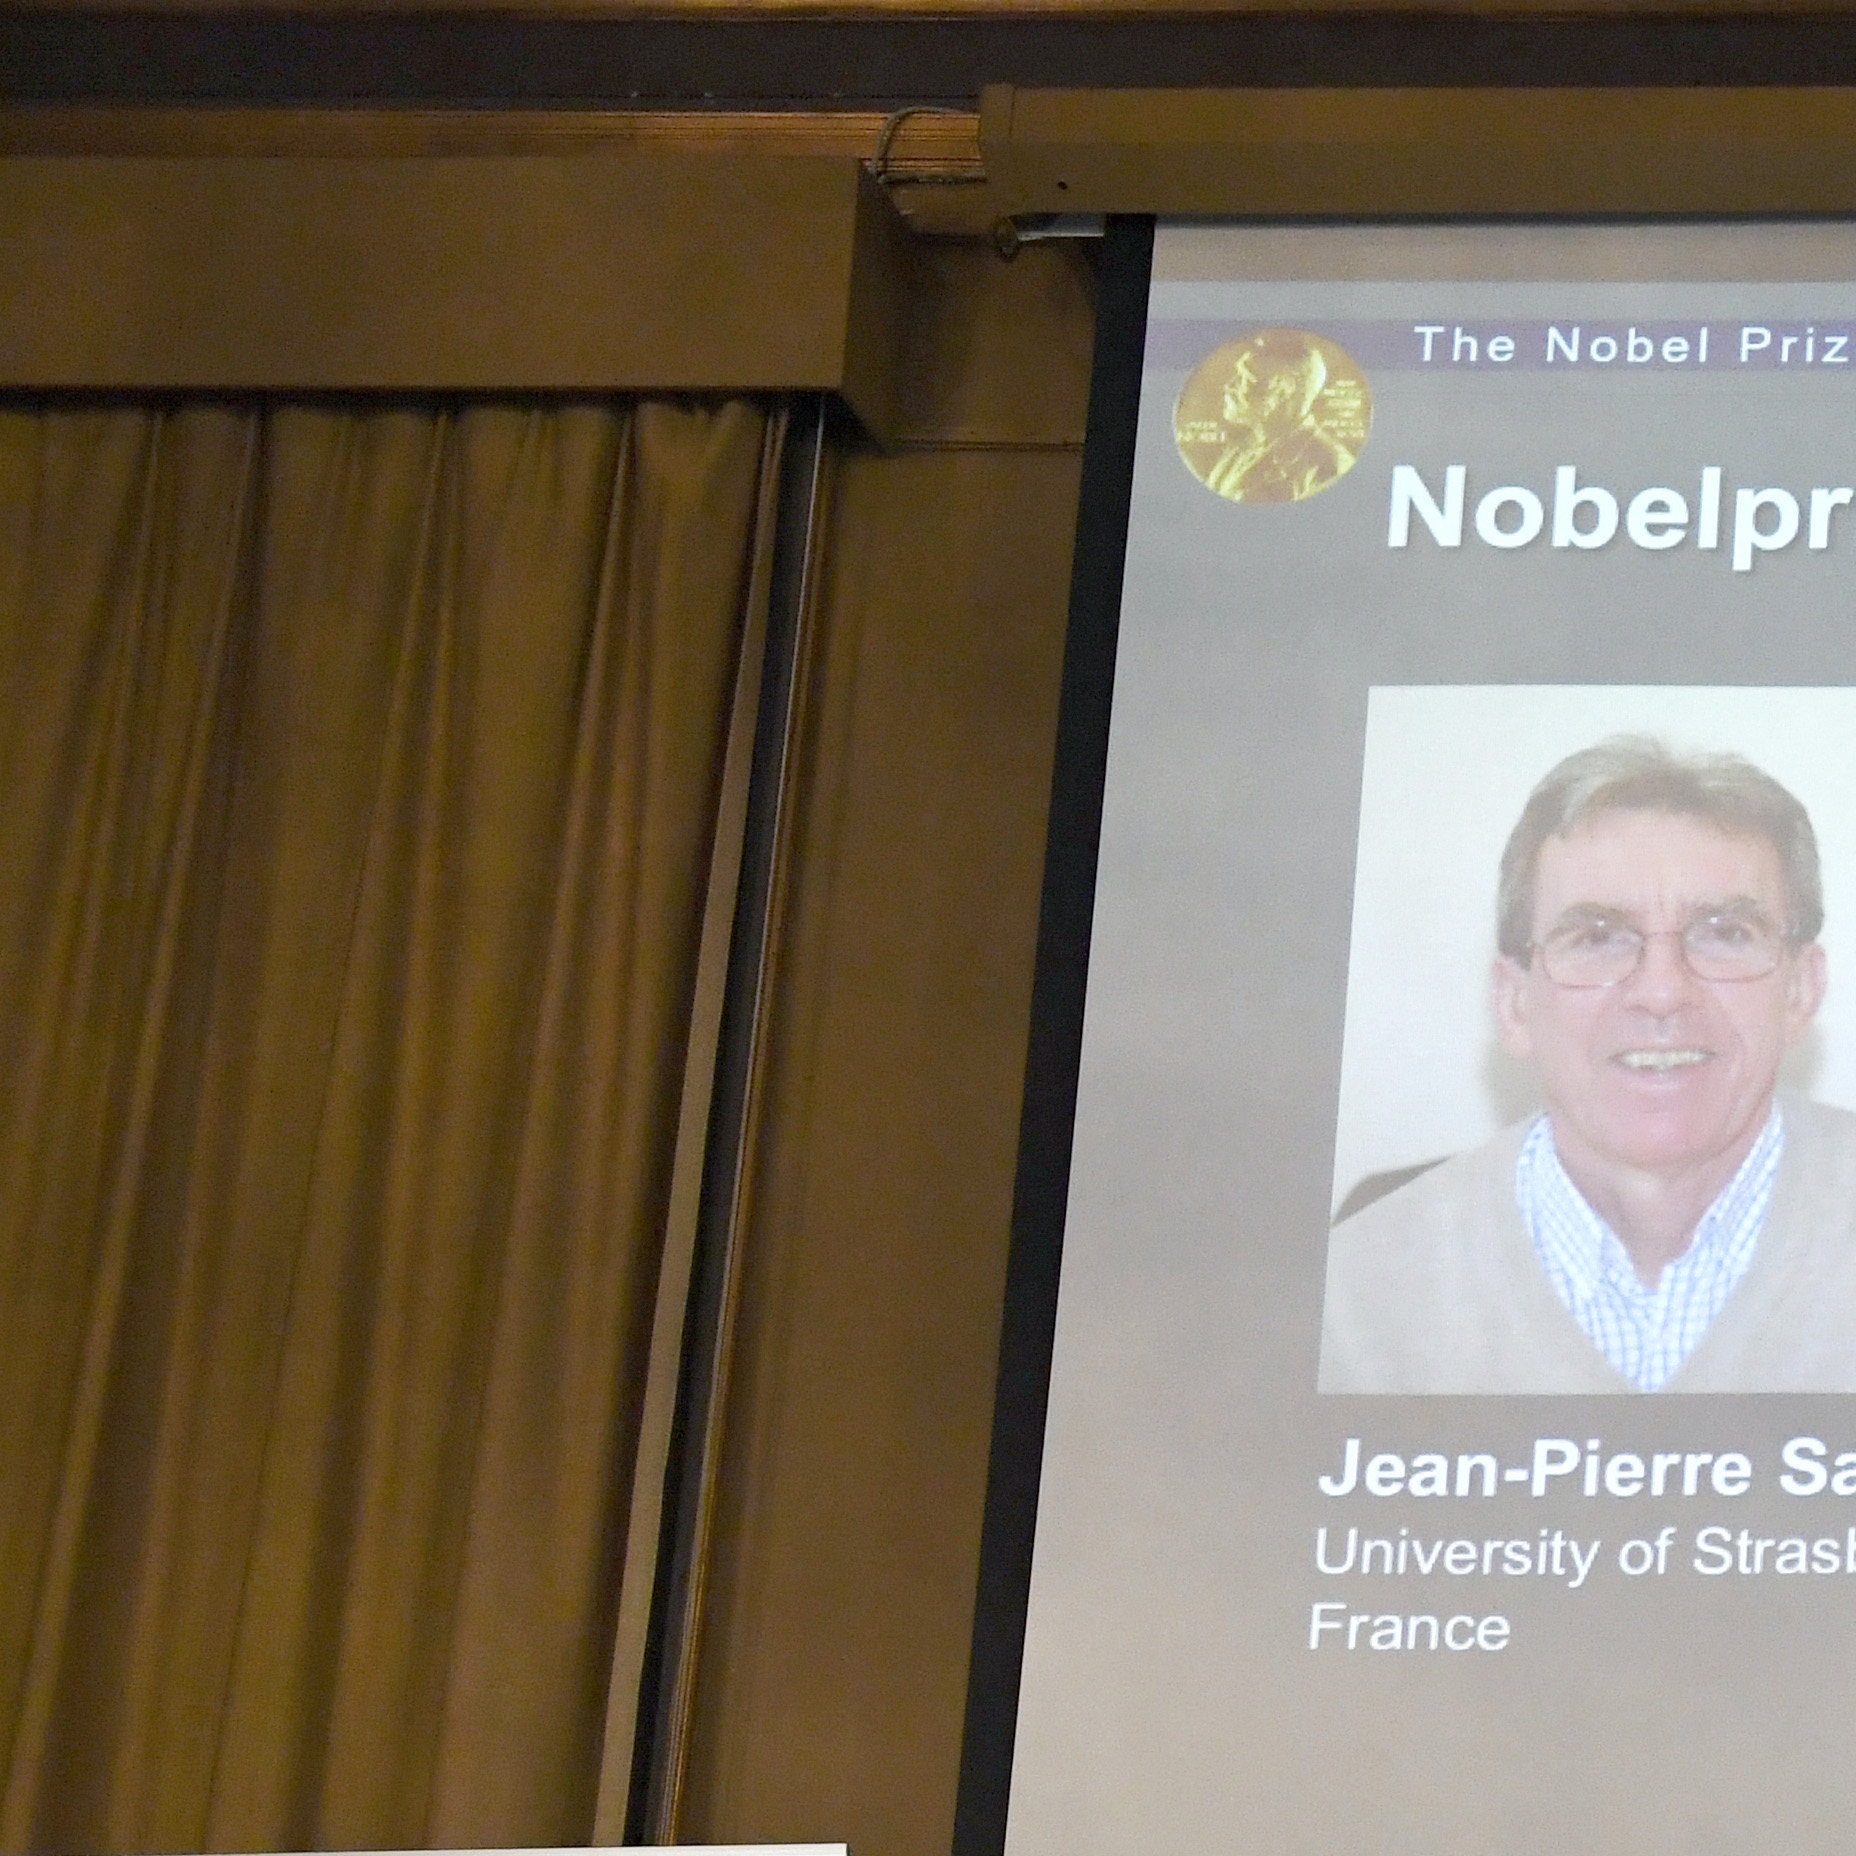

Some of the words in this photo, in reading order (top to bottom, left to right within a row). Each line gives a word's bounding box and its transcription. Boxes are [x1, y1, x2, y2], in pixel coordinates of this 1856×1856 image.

[1414, 326, 1515, 362] The
[1546, 326, 1708, 363] Nobel
[1317, 1437, 1753, 1498] Jean-Pierre
[1314, 1527, 1602, 1588] University
[1617, 1526, 1678, 1576] of
[1308, 1602, 1512, 1652] France
